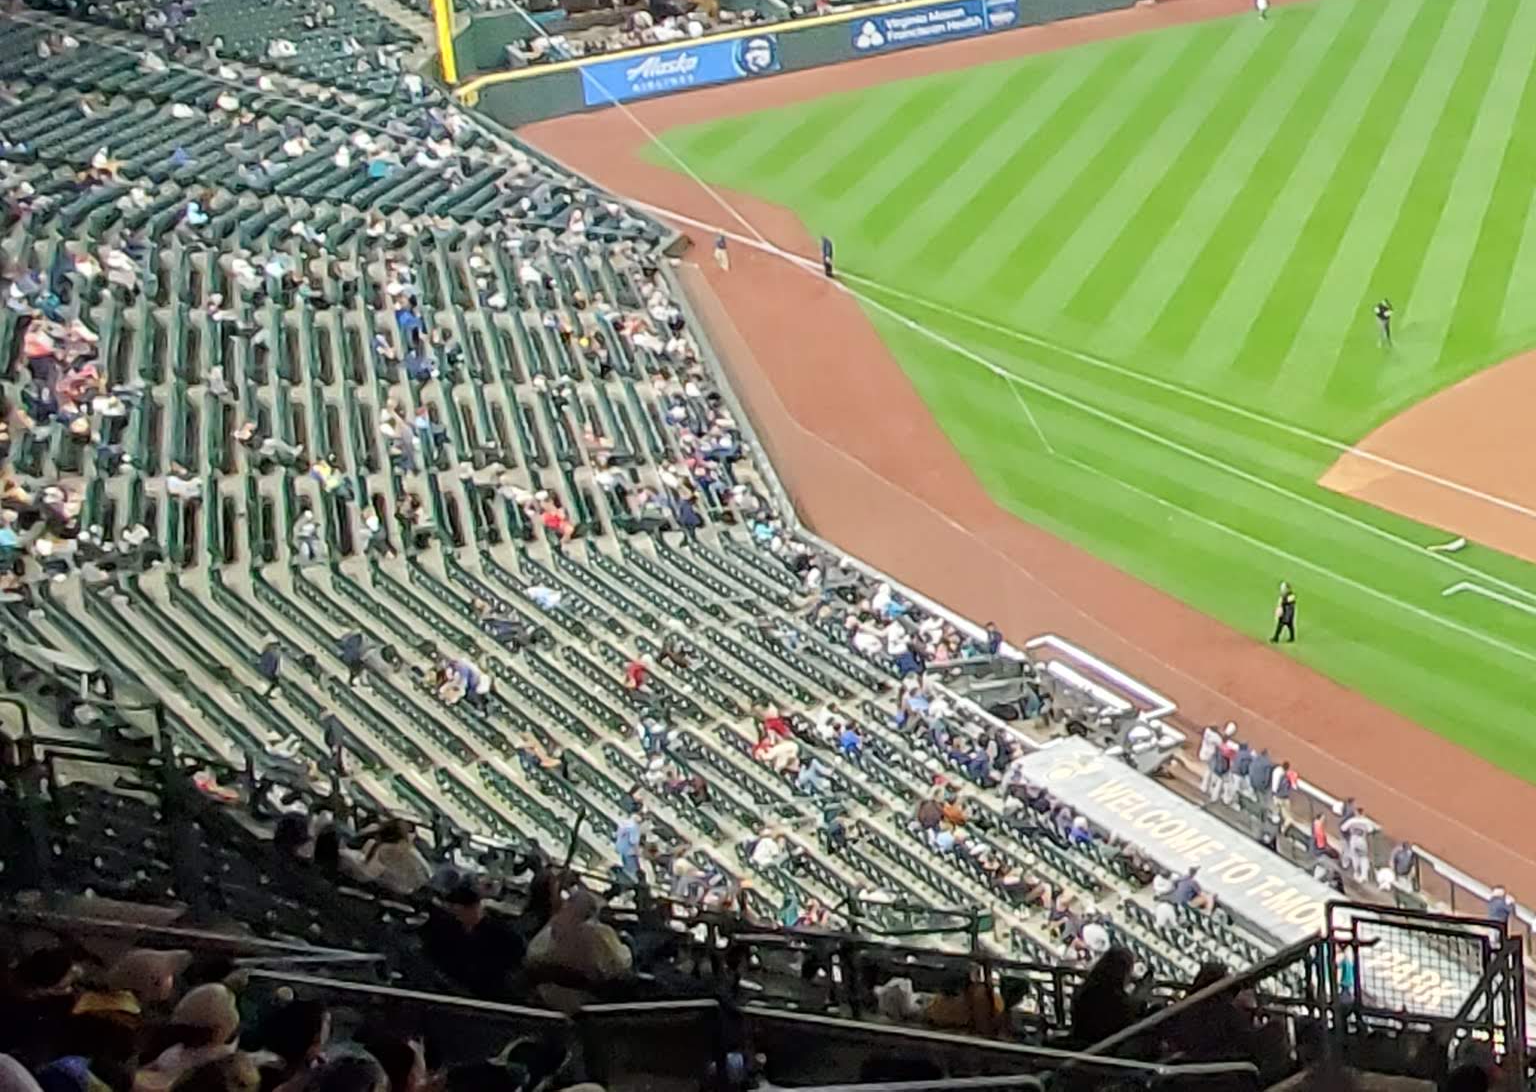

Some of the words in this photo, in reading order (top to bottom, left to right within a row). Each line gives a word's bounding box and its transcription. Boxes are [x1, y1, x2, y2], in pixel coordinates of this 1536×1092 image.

[626, 52, 699, 81] Alaska
[1088, 778, 1227, 863] WELCOME
[1206, 850, 1262, 885] TO
